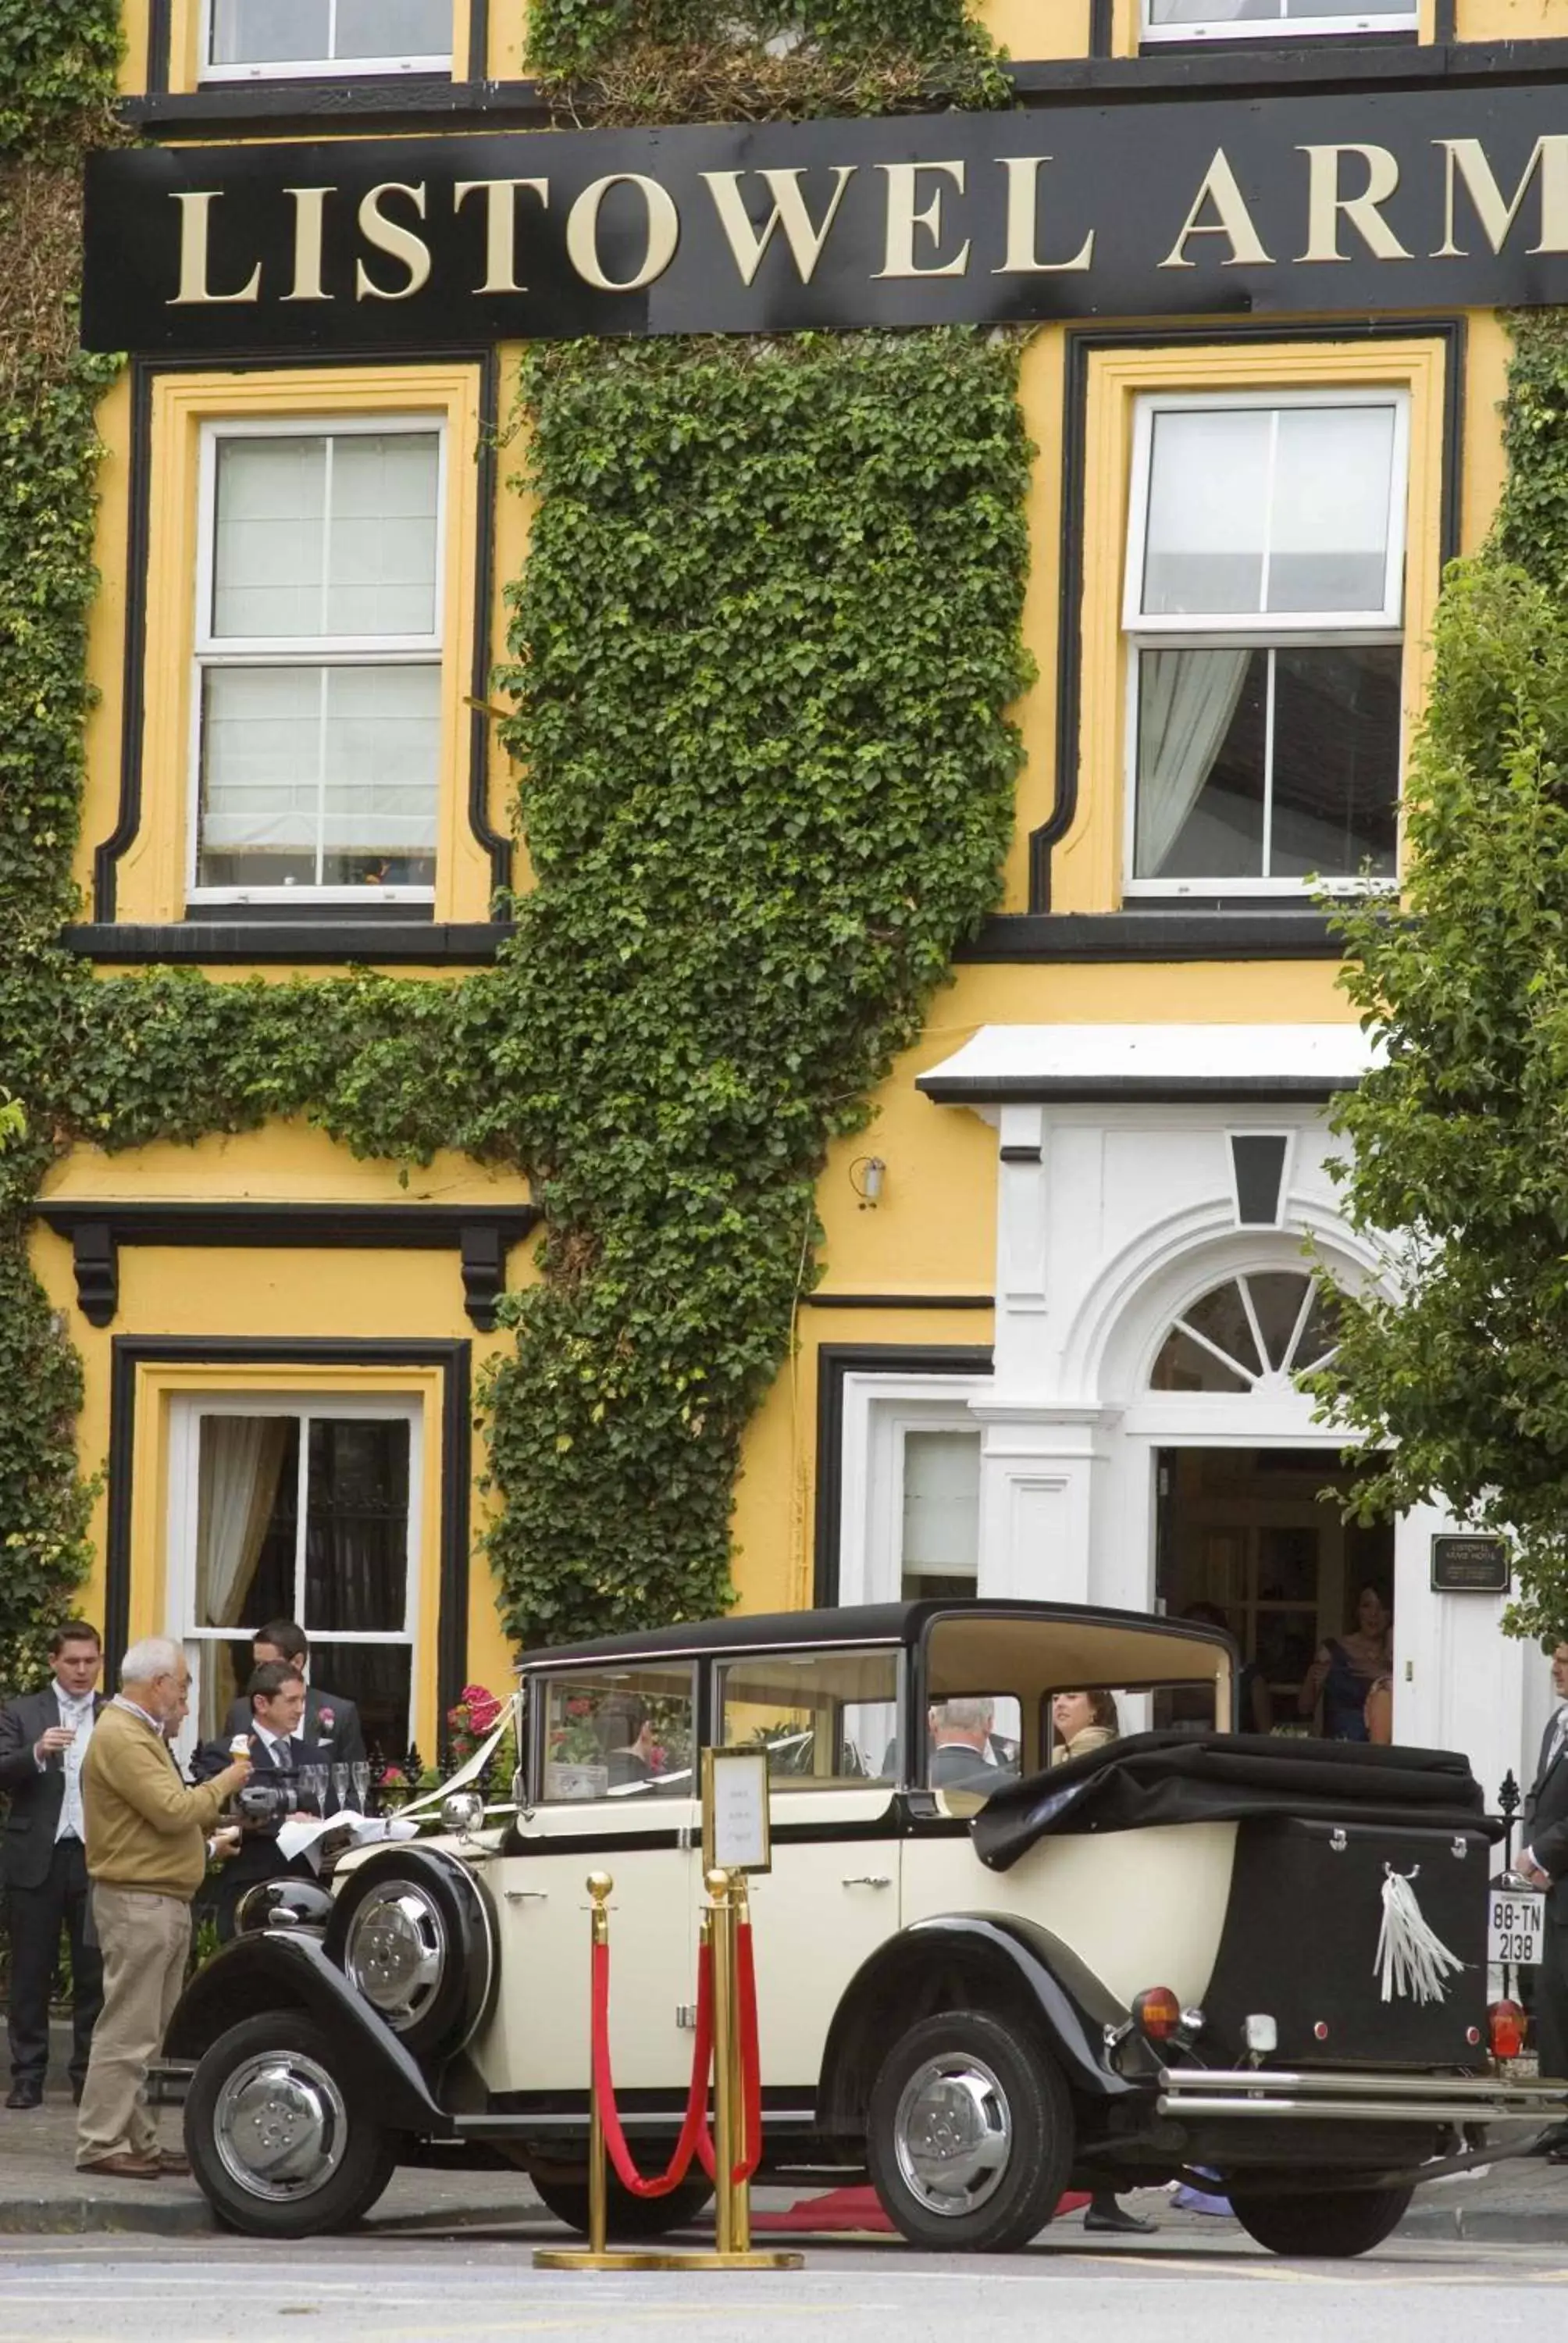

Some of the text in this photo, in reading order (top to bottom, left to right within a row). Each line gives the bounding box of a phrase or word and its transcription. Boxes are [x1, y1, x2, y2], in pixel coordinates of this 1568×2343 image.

[166, 134, 1568, 305] LISTOWEL ARM
[1493, 1903, 1541, 1931] 88-TN
[1499, 1933, 1534, 1961] 2138
